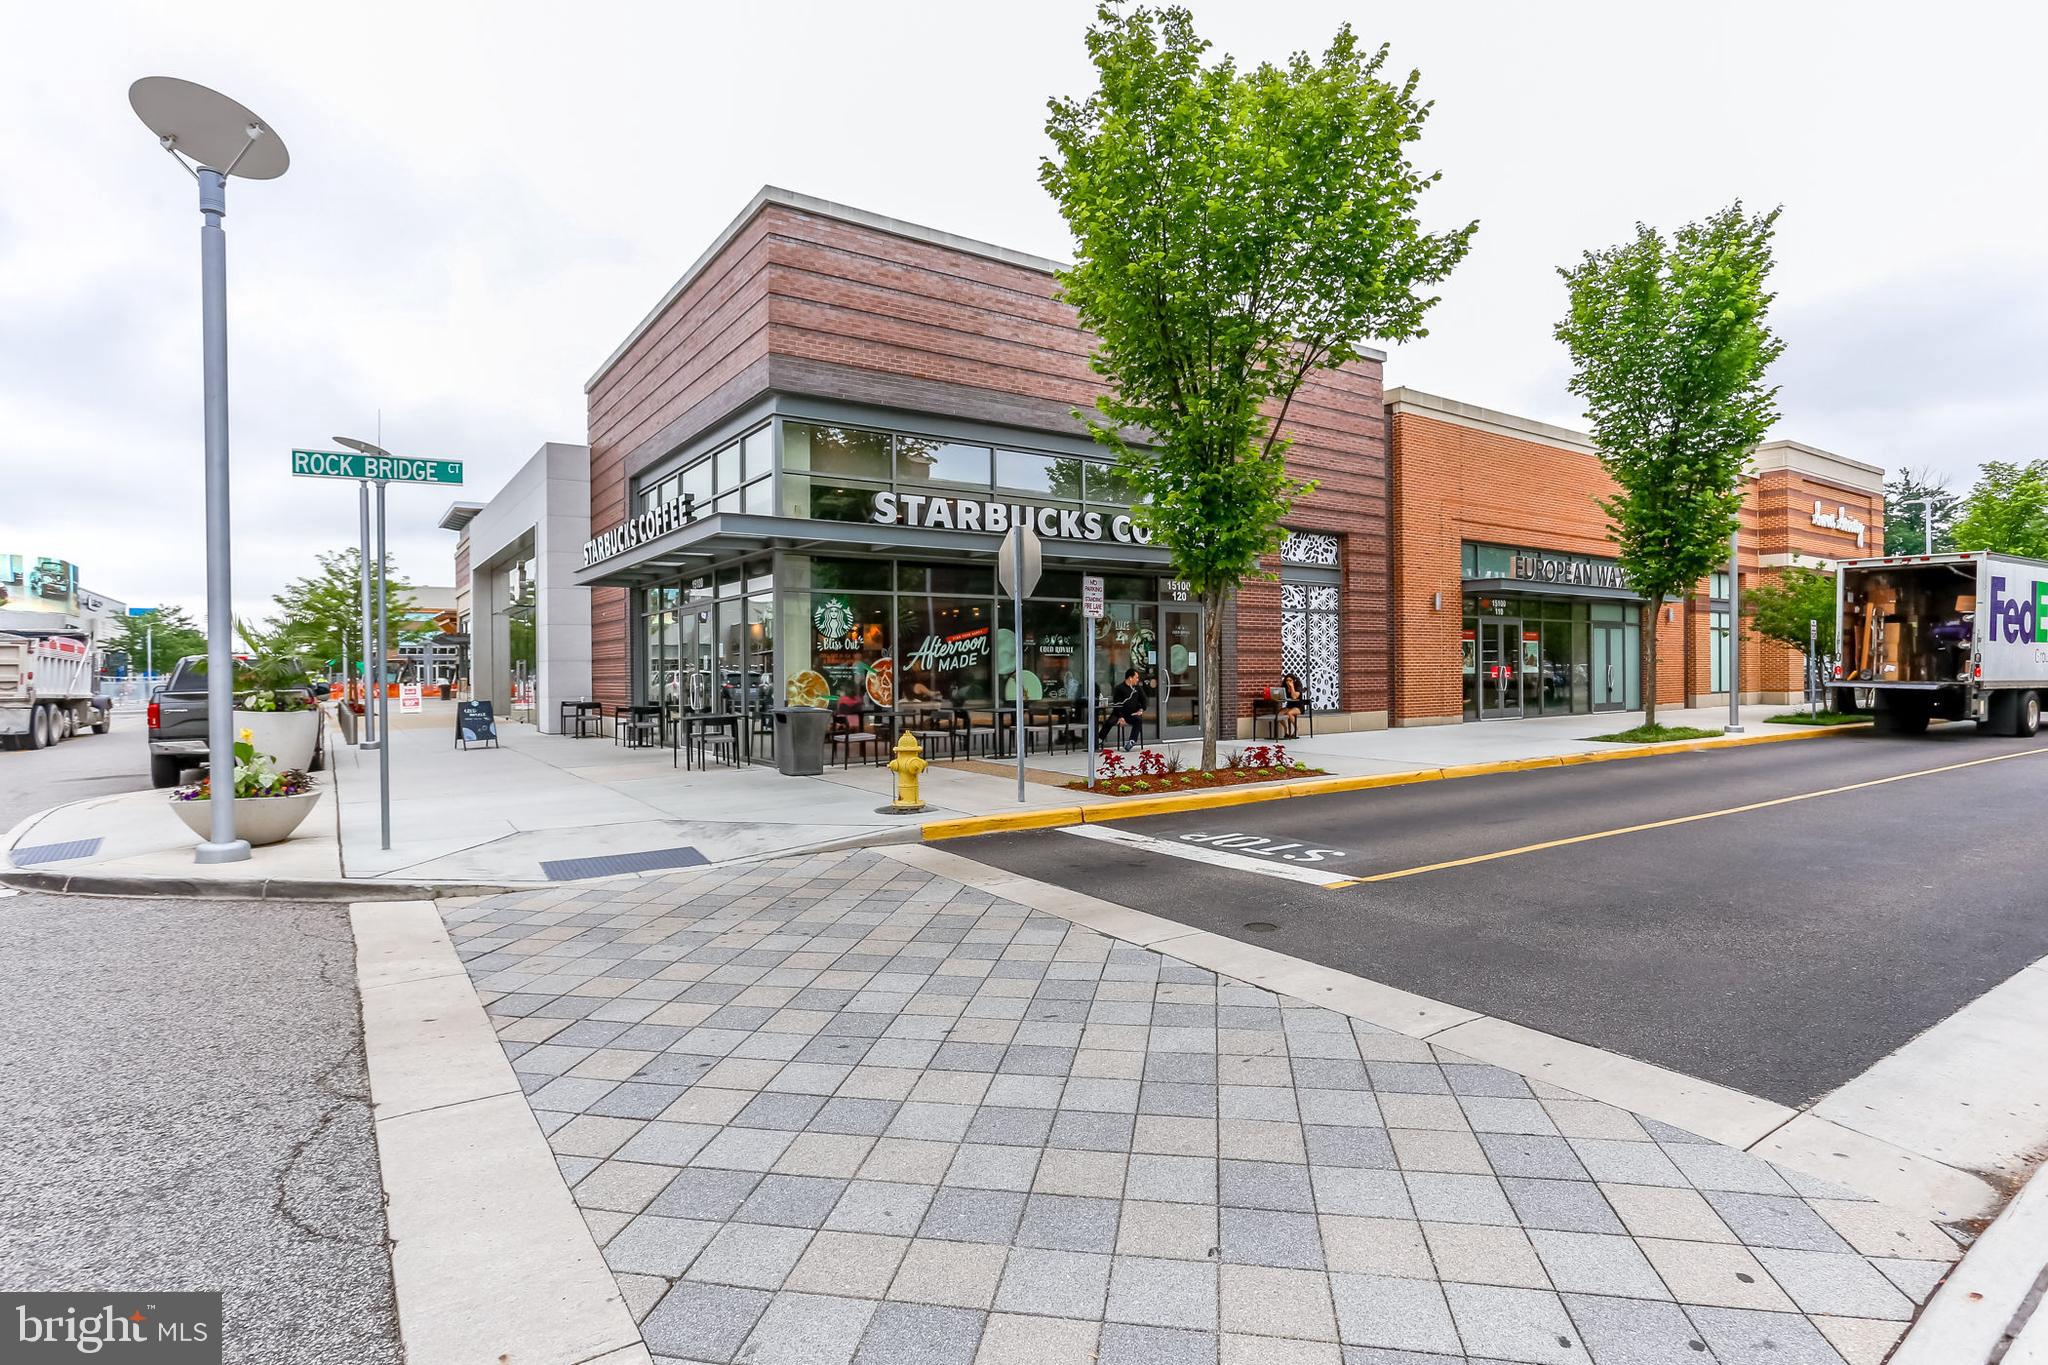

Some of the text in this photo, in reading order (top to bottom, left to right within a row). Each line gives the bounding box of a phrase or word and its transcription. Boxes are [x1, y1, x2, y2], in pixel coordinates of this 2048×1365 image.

[295, 453, 461, 481] ROCK BRIDGE CT
[873, 491, 1102, 540] STARBUCKS
[583, 493, 693, 567] STARBUCKS COFFEE
[1515, 557, 1593, 585] EUROPEAN
[1084, 585, 1103, 593] PARKING
[1167, 580, 1191, 591] 15100
[1172, 591, 1187, 601] 120
[1492, 599, 1507, 608] 15100
[1495, 608, 1504, 616] 110
[823, 637, 860, 650] Bliss Out
[902, 635, 990, 672] Afternoon
[938, 652, 978, 673] MADE
[1179, 832, 1346, 862] STOP
